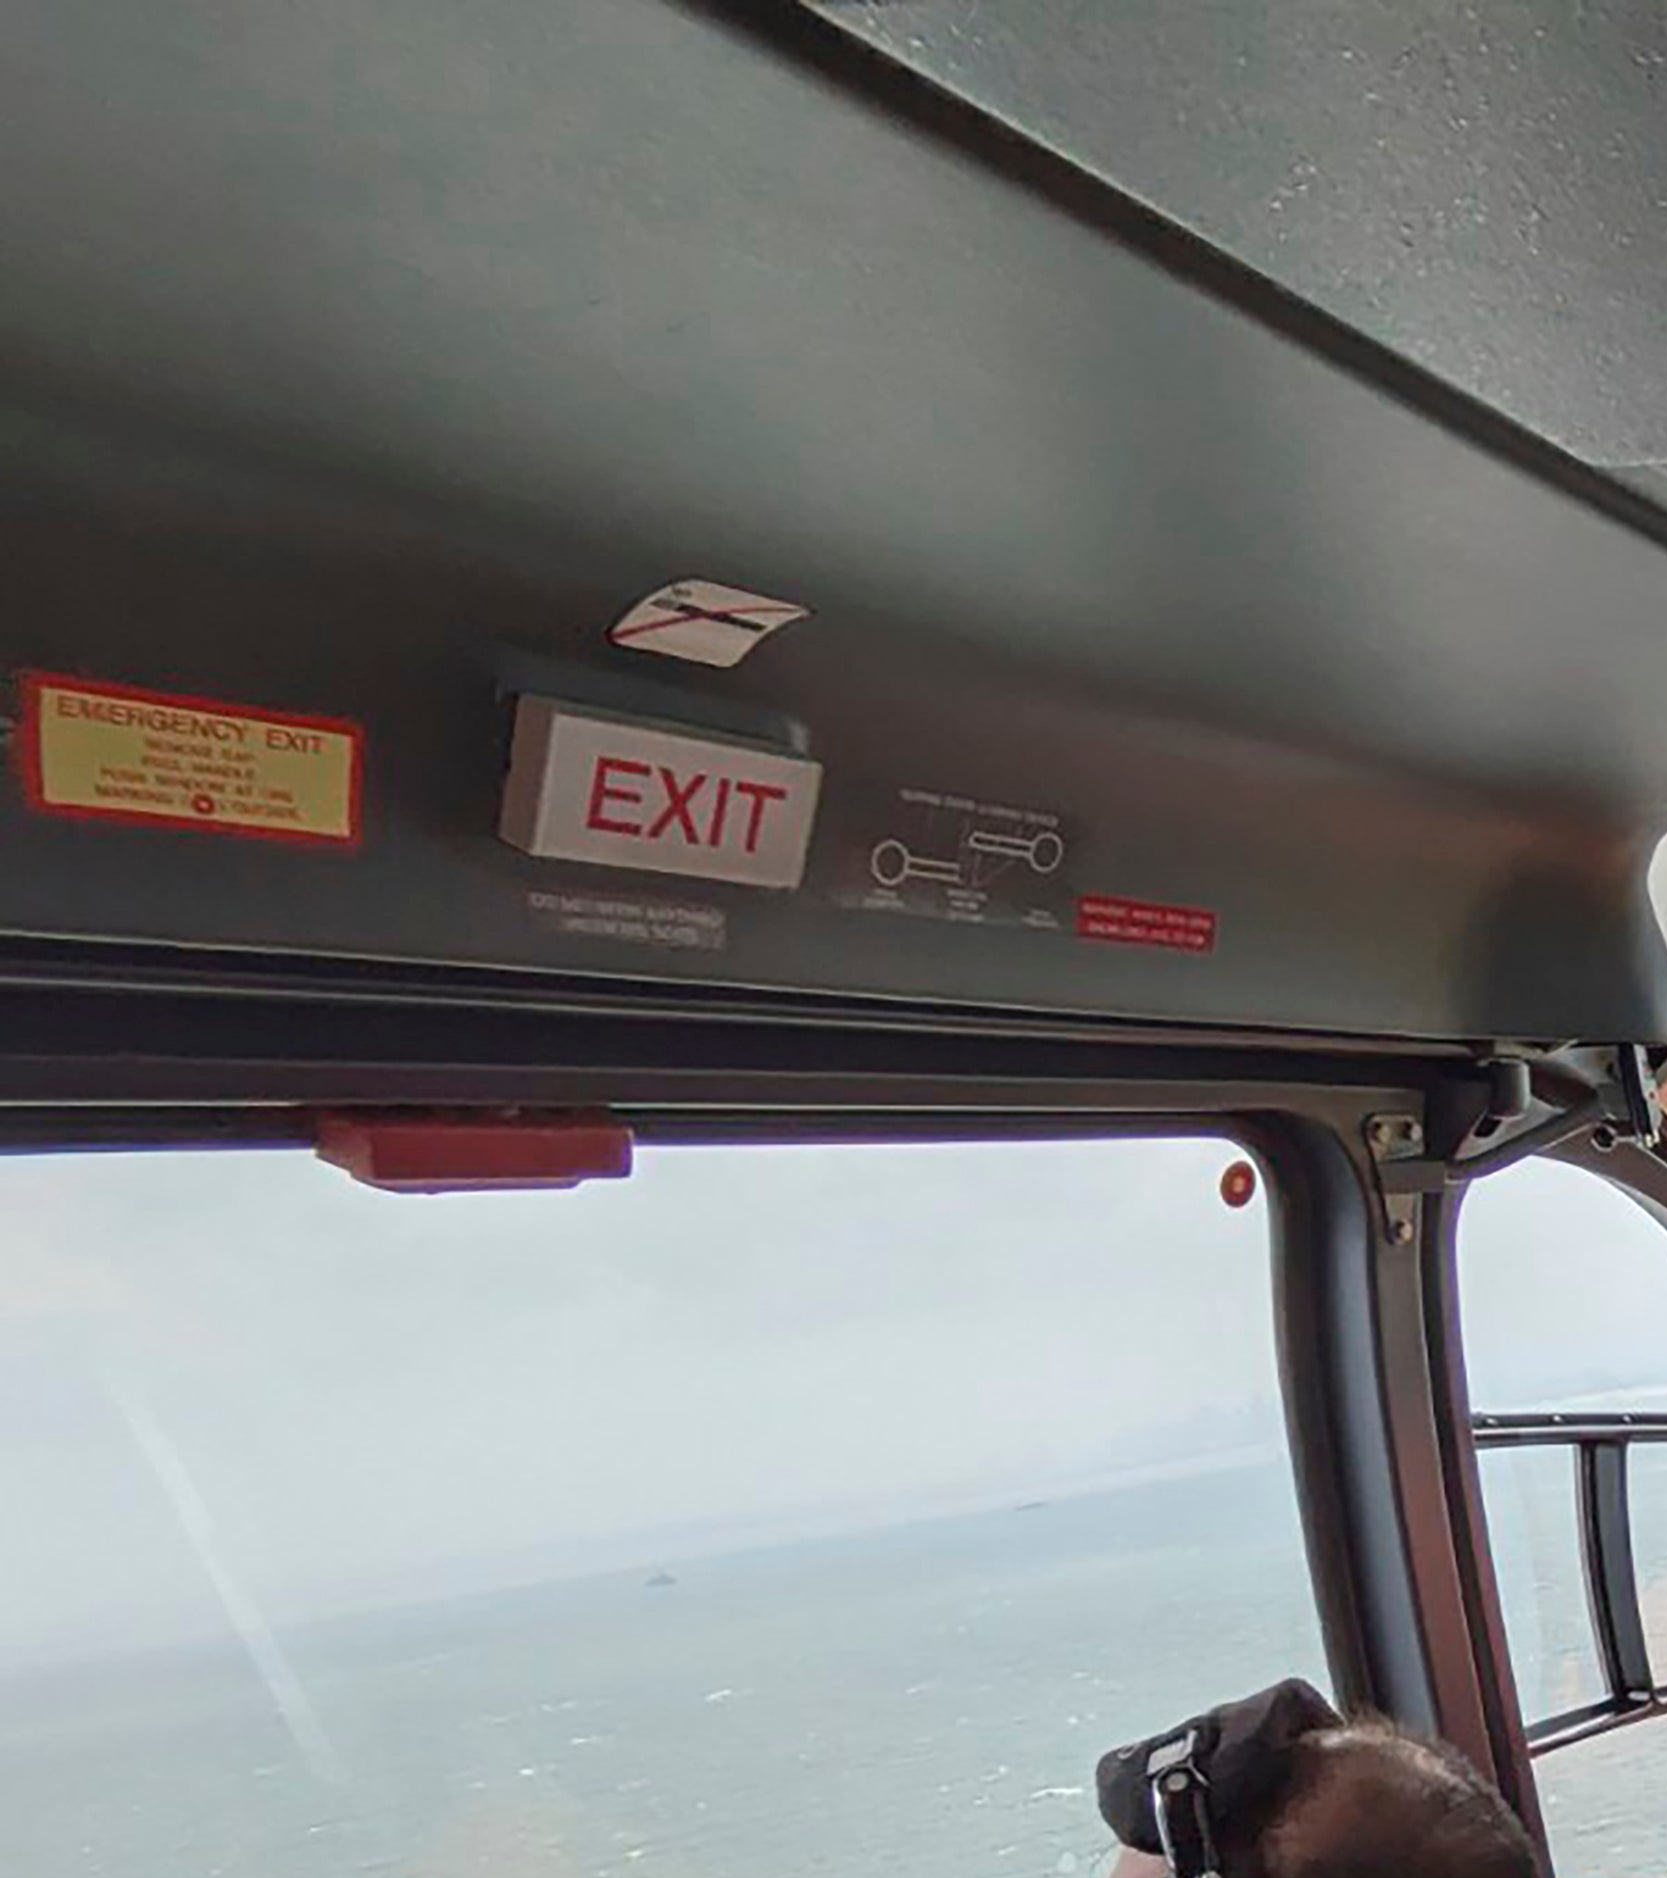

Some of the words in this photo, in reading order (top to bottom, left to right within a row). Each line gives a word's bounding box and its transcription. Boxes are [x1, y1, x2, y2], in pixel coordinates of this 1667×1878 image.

[56, 695, 247, 742] EMERGENCY
[265, 728, 325, 754] EXIT
[586, 756, 788, 853] EXIT
